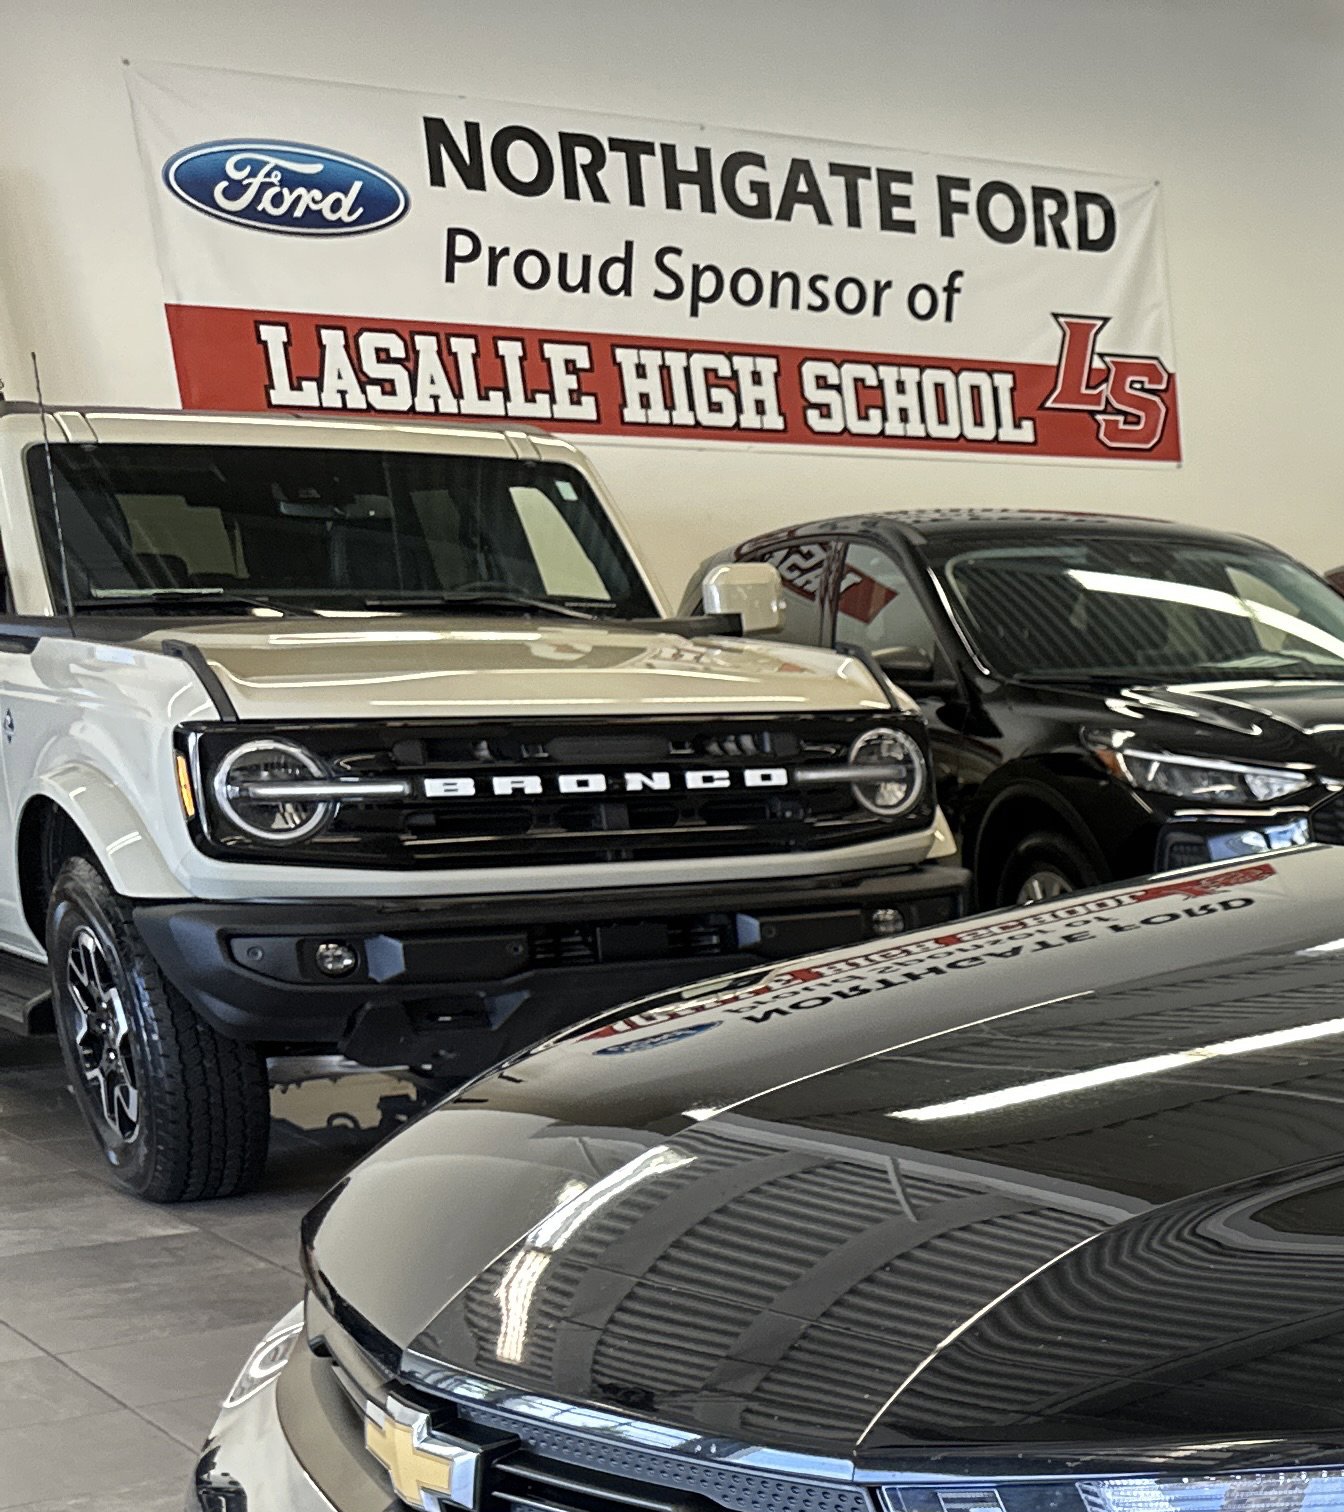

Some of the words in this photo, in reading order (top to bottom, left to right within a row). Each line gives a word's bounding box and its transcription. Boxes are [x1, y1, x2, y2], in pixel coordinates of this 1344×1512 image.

[213, 152, 364, 223] Ford
[422, 116, 917, 235] NORTHGATE
[936, 174, 1117, 253] FORD
[444, 227, 635, 297] Proud
[652, 245, 893, 318] Sponsor
[907, 269, 965, 323] of
[255, 319, 600, 424] LASALLE
[613, 344, 786, 433] HIGH
[799, 357, 1037, 445] SCHOOL
[1039, 312, 1171, 451] LS
[424, 768, 788, 797] BRONCO
